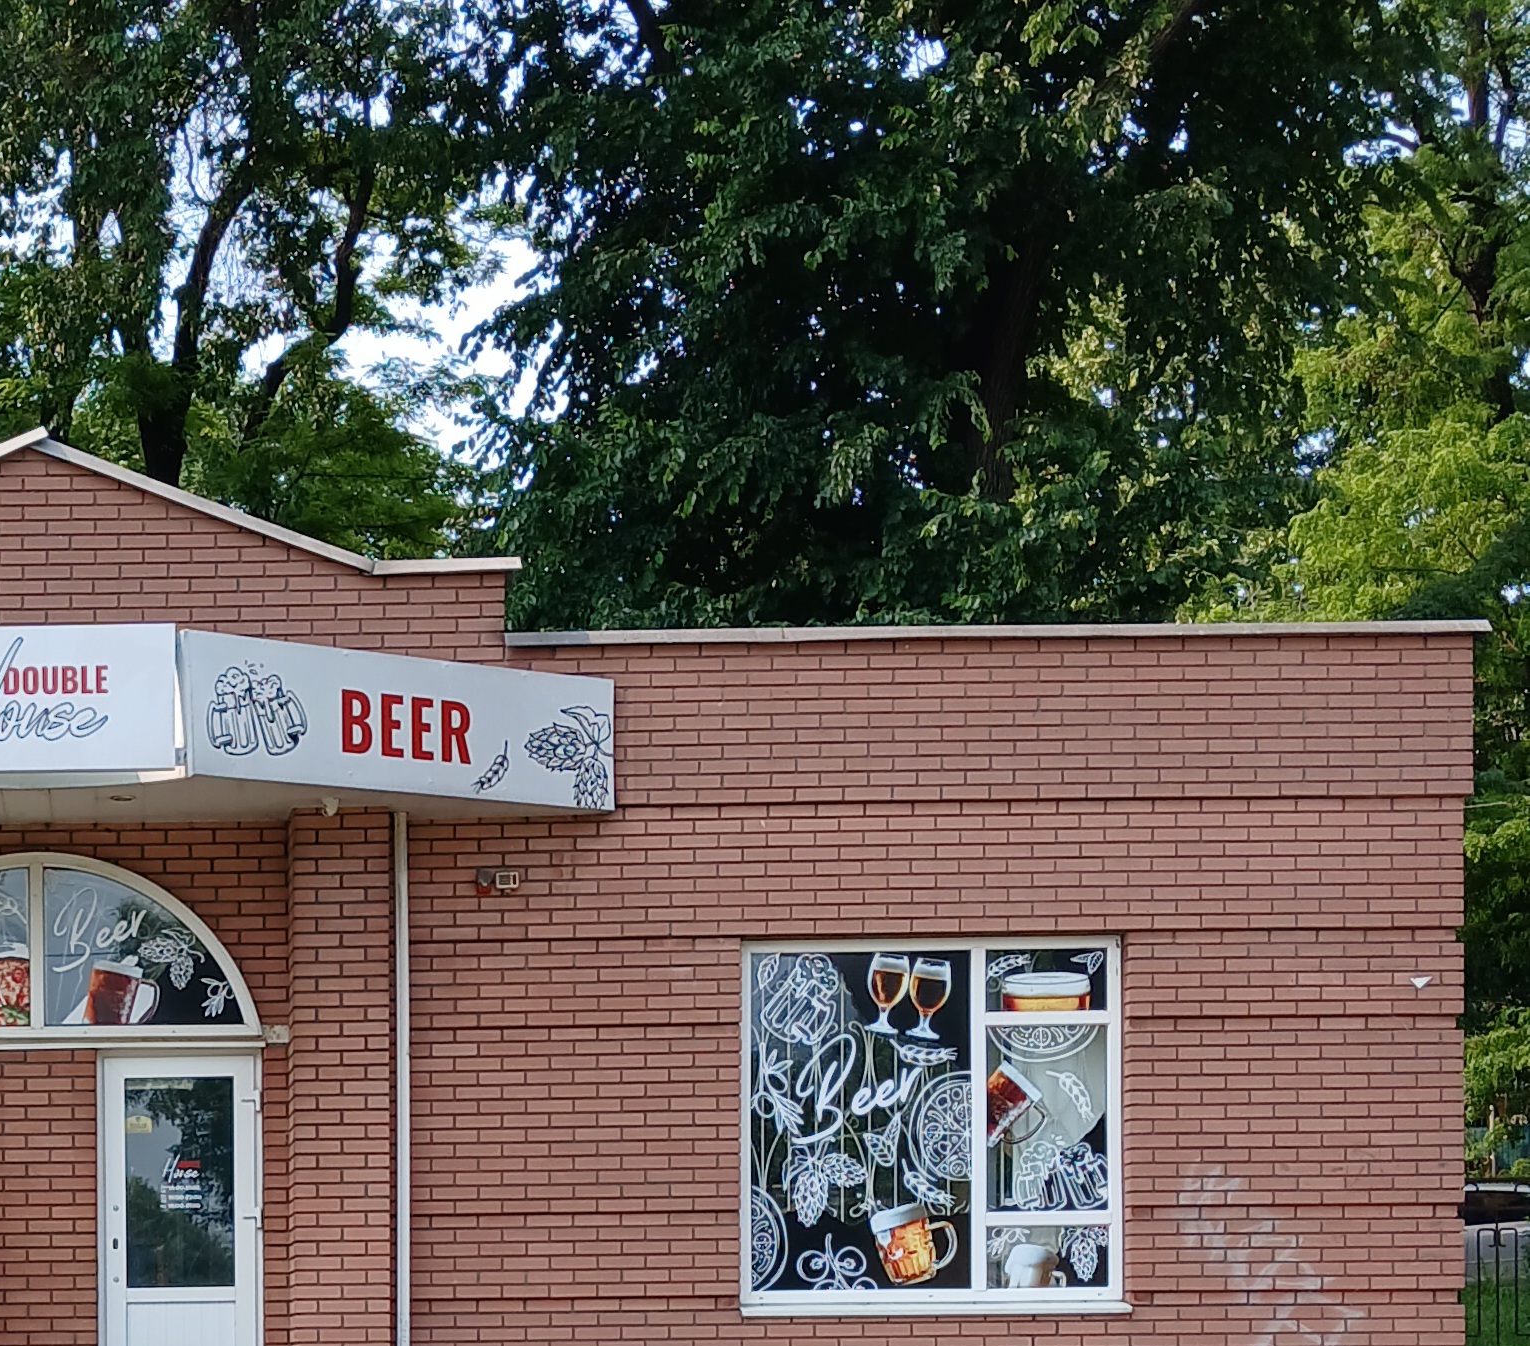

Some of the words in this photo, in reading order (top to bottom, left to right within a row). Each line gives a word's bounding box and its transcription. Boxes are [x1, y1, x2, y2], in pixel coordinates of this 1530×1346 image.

[3, 665, 110, 696] DOUBLE
[340, 688, 473, 765] BEER
[52, 886, 149, 973] Beer
[791, 1033, 923, 1145] Beer
